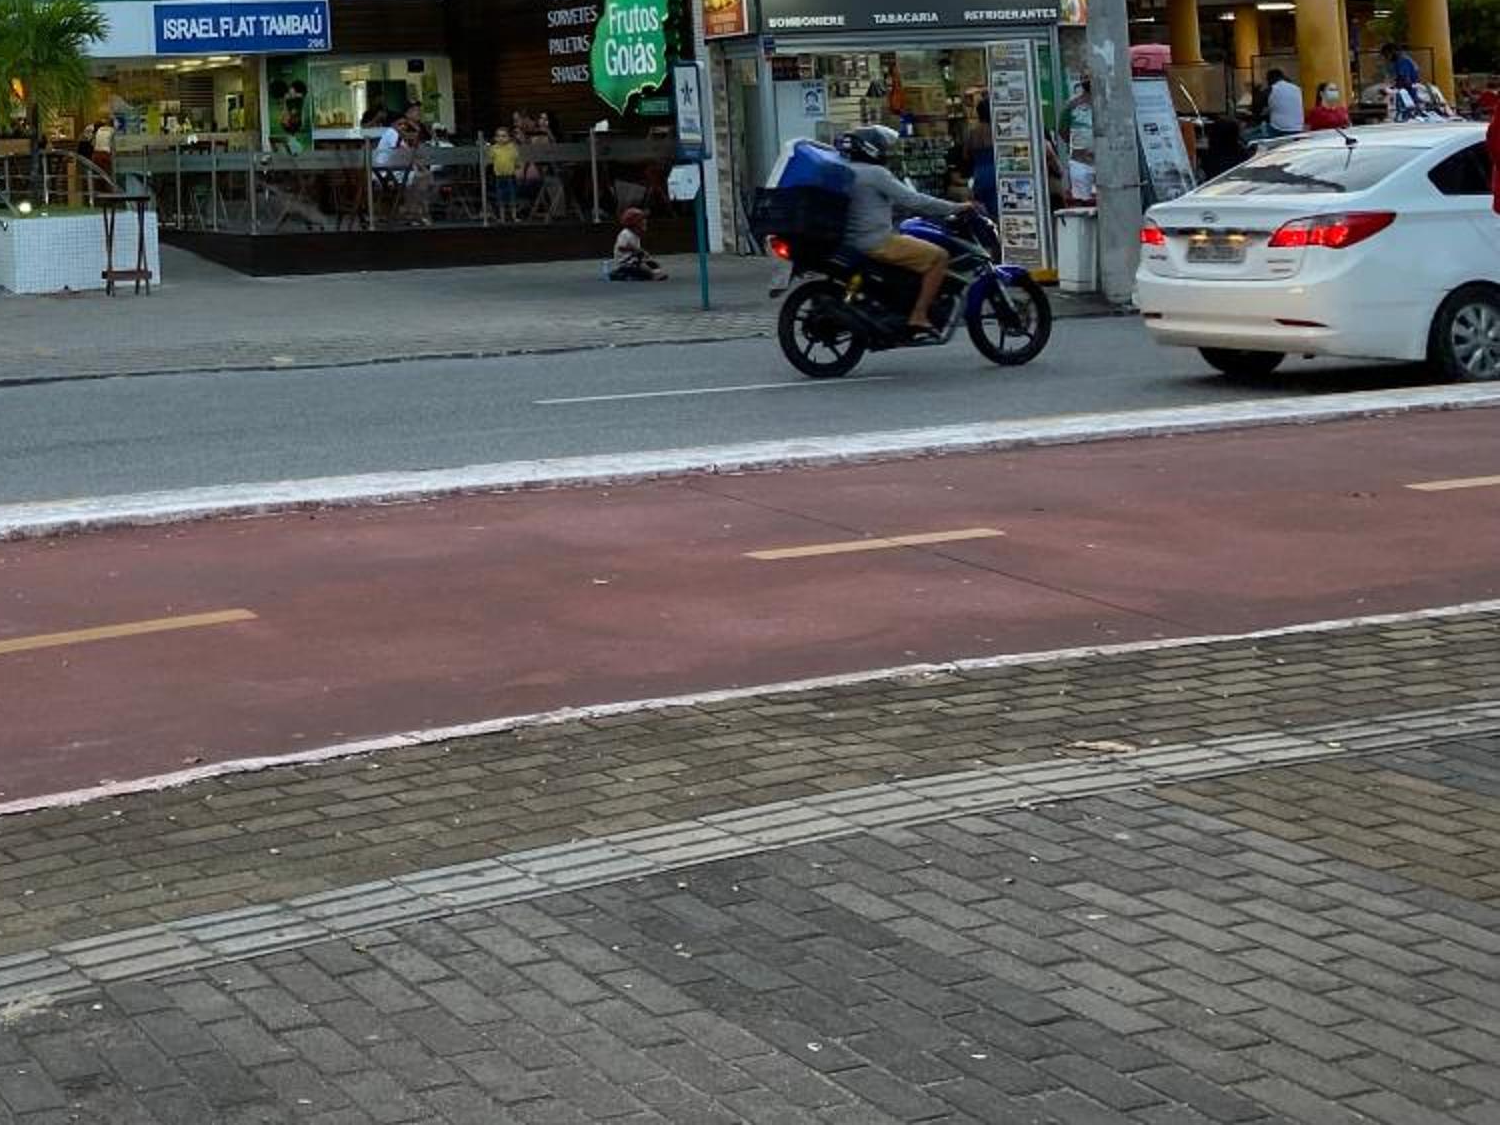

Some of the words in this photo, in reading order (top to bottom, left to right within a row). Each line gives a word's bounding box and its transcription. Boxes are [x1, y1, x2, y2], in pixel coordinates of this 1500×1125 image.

[163, 18, 219, 40] ISRAEL
[219, 16, 257, 37] FLAT
[260, 6, 322, 35] TAMBAÚ
[547, 4, 598, 28] SORVETES
[608, 2, 659, 35] Frutos
[768, 15, 845, 28] BOMBONIERE
[873, 12, 939, 25] TABACARIA
[964, 7, 1058, 21] REFRIGERANTES
[549, 34, 592, 55] PALETAS
[604, 36, 658, 76] Goiás
[551, 64, 591, 84] SHAKES
